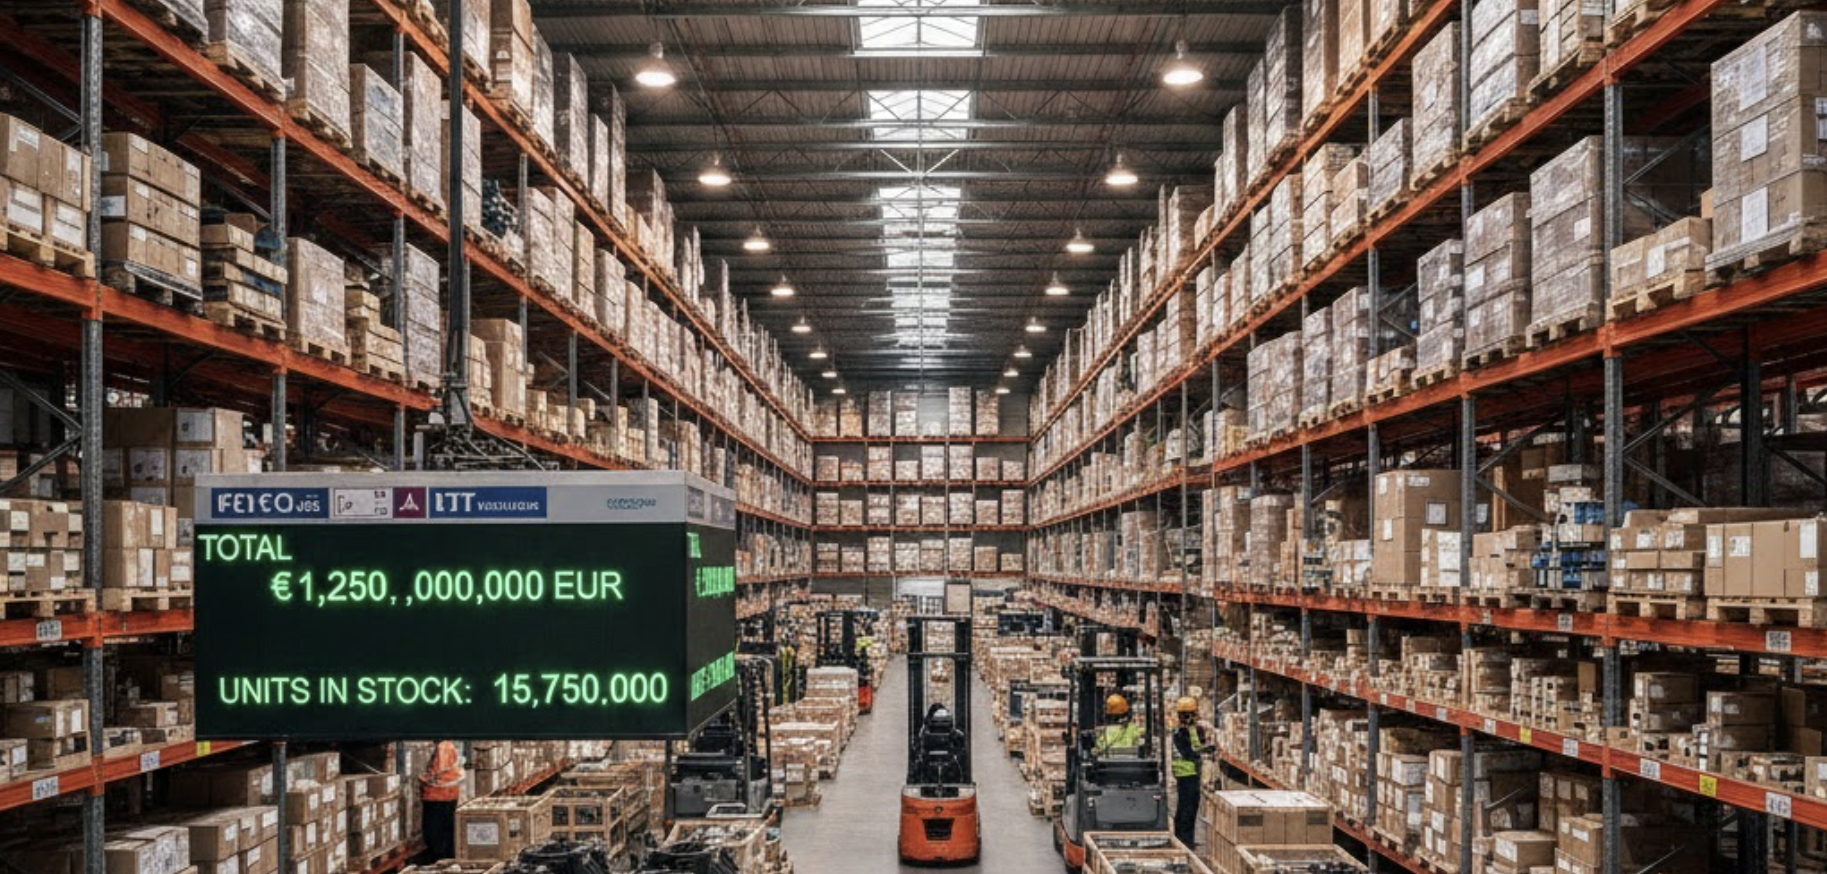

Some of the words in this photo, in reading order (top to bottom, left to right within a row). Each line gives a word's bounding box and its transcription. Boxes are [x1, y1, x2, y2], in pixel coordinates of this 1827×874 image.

[197, 533, 293, 562] TOTAL
[553, 570, 624, 601] EUR
[219, 676, 311, 705] UNITS
[318, 676, 349, 705] IN
[357, 676, 472, 705] STOCK:
